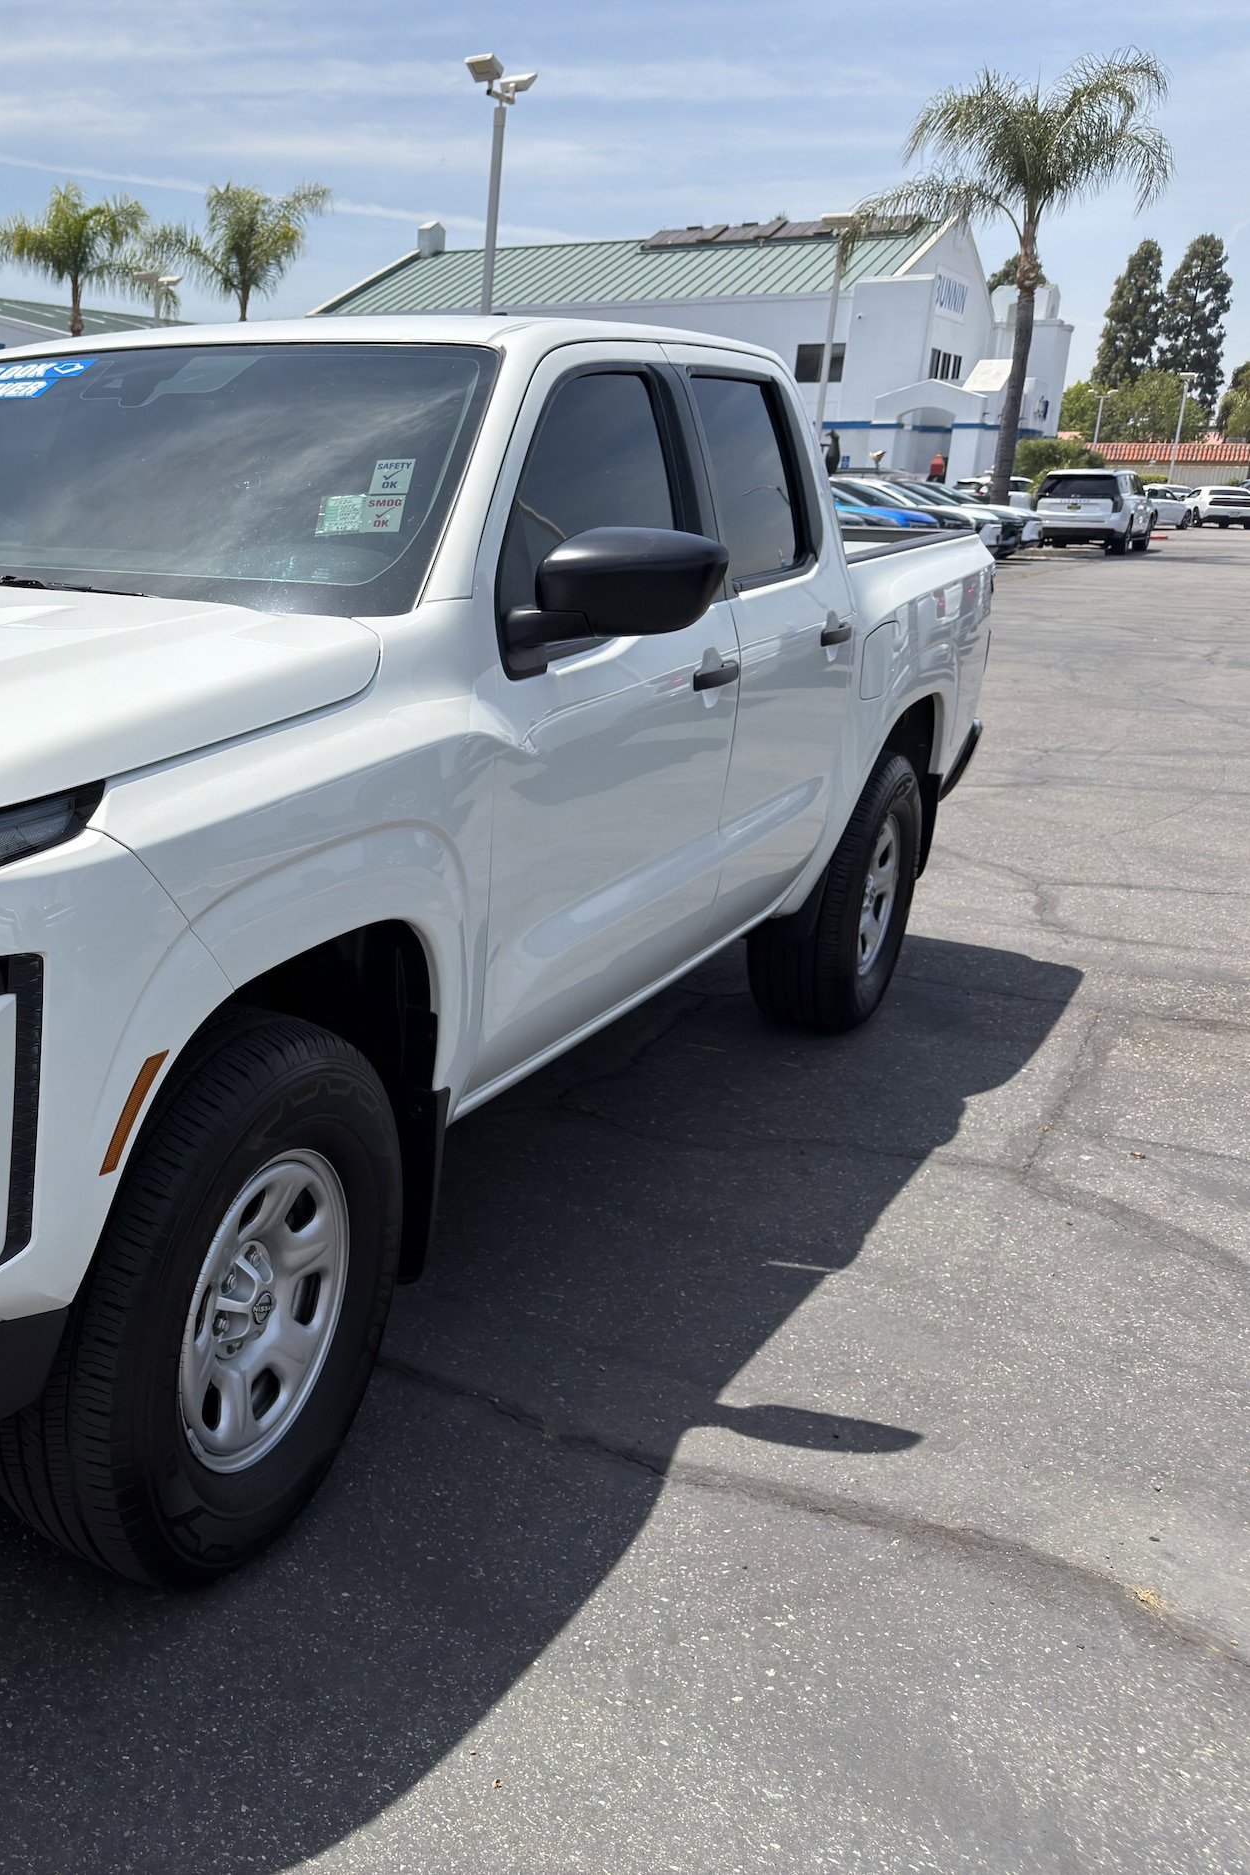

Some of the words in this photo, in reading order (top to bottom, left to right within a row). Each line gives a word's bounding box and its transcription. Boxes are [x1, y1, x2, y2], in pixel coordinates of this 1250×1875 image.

[377, 462, 412, 471] SAFETY
[381, 481, 398, 489] OK
[368, 499, 402, 508] SMOG
[373, 519, 389, 528] OK
